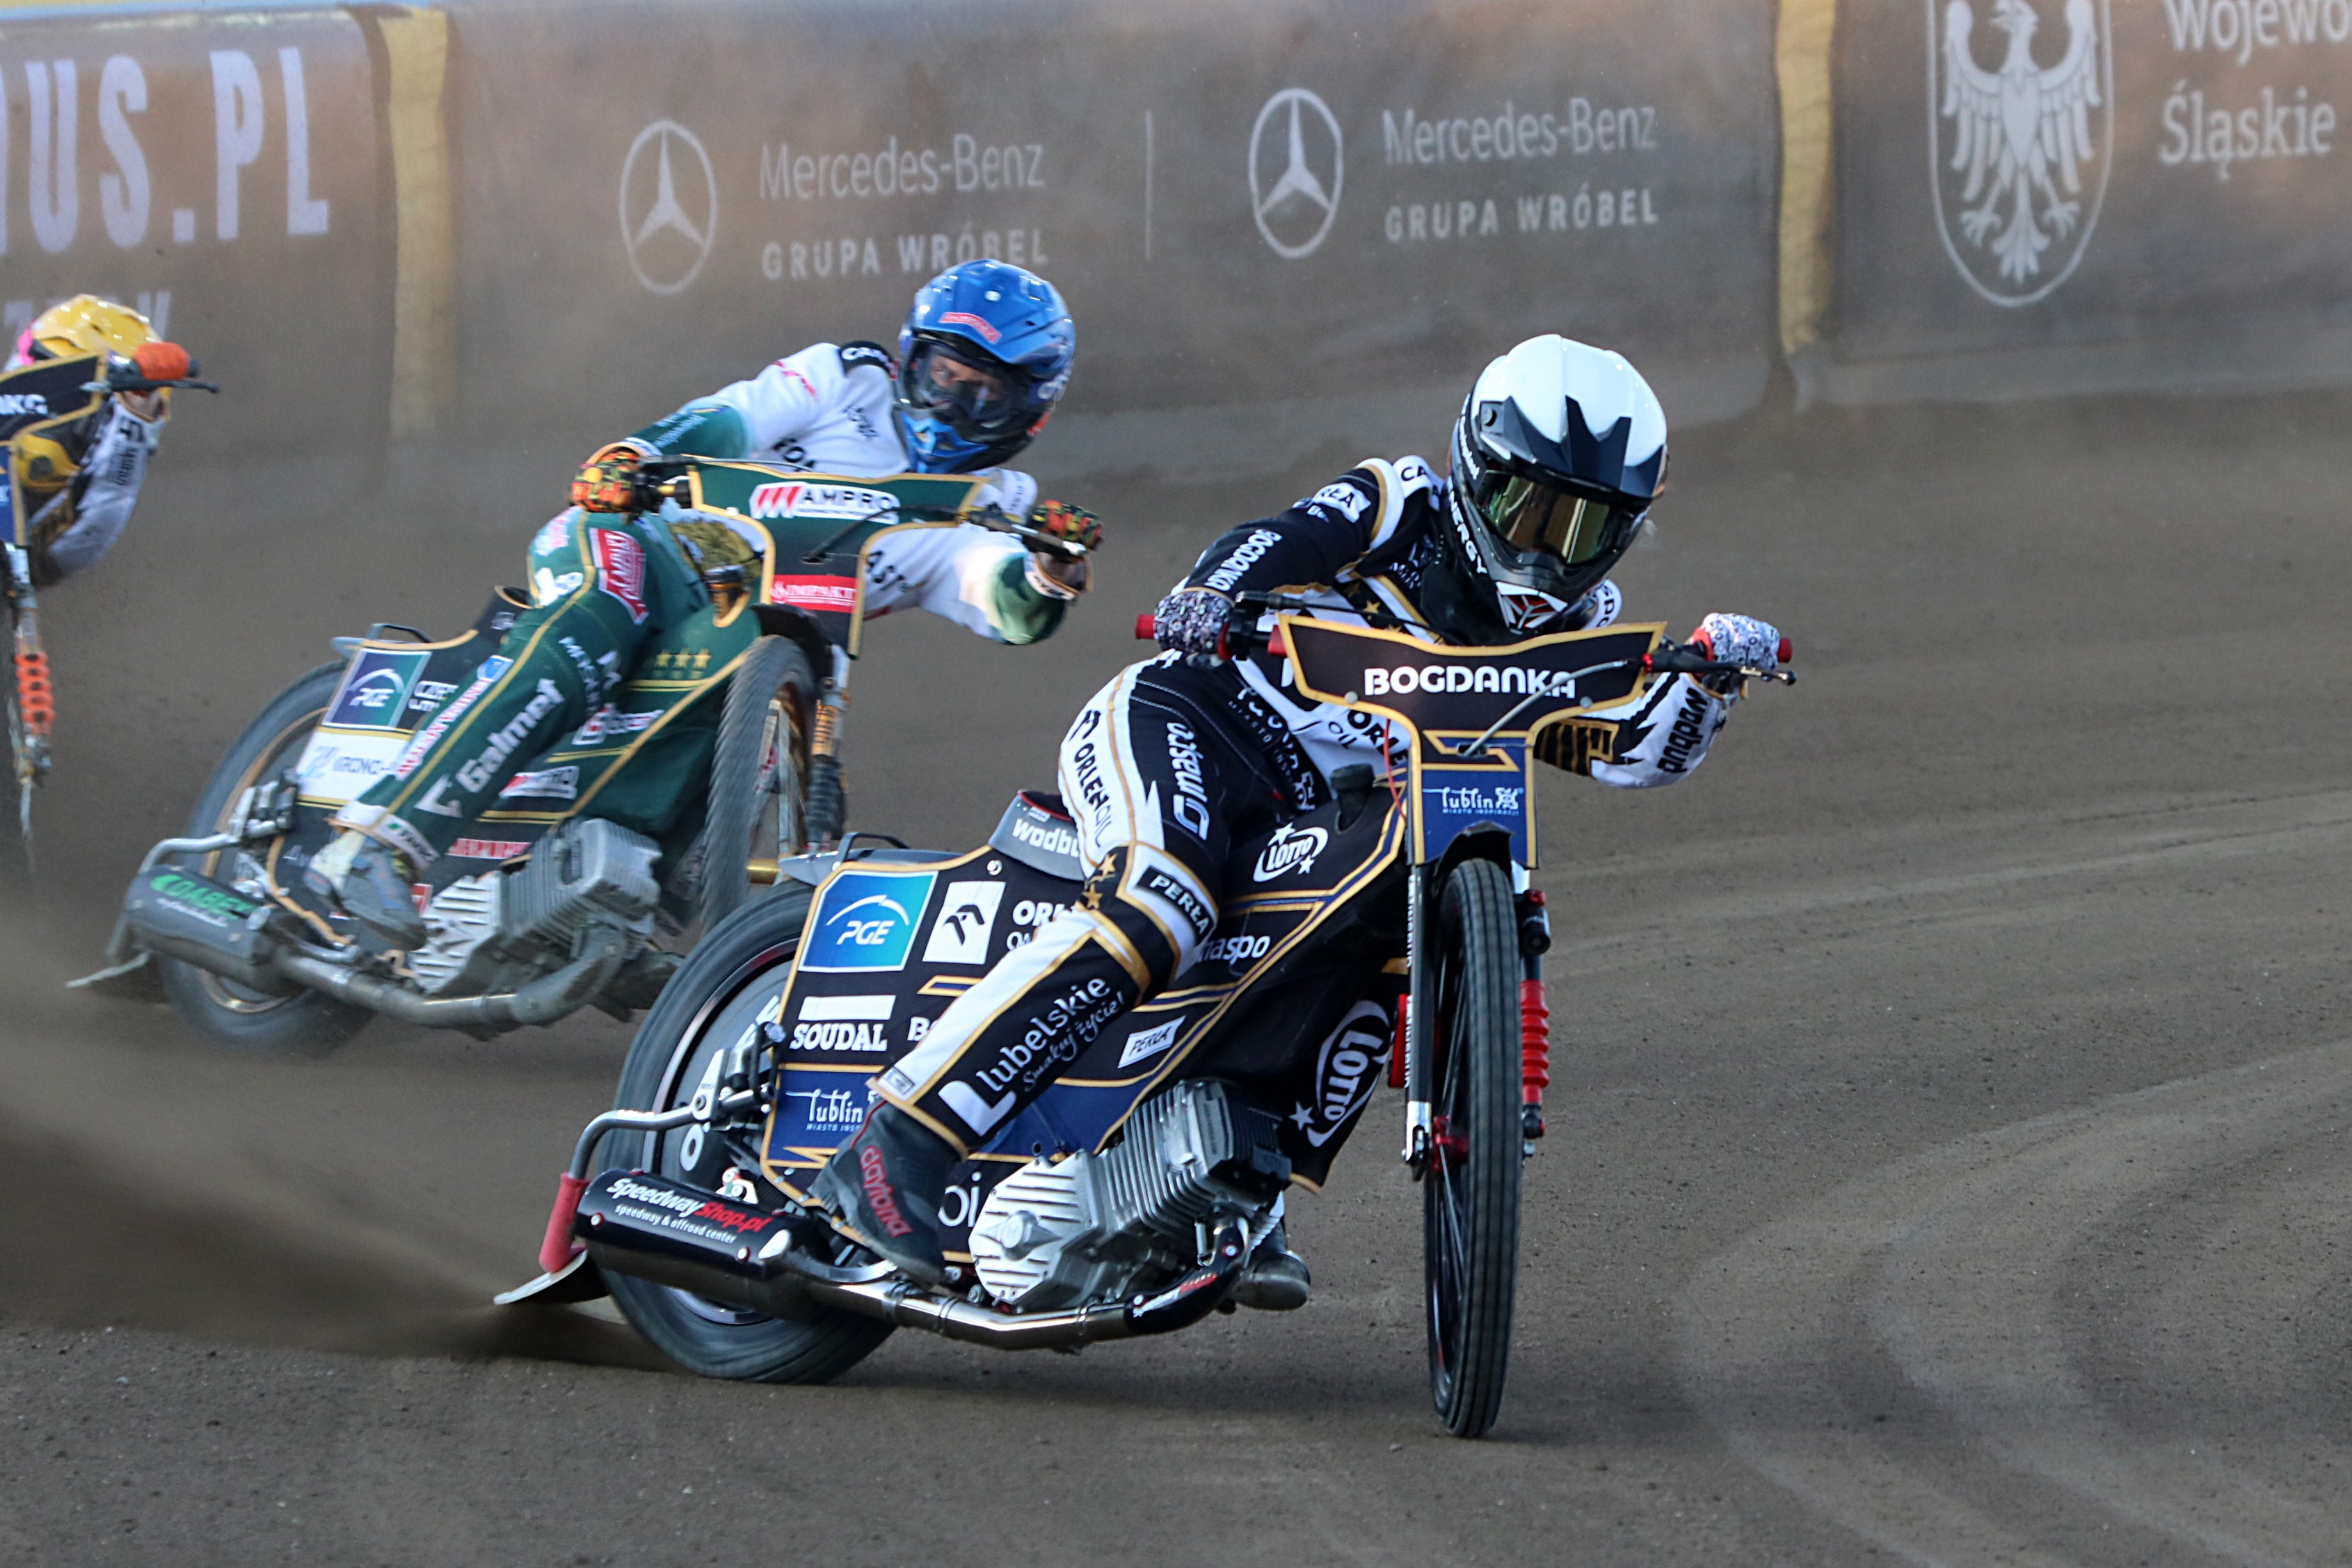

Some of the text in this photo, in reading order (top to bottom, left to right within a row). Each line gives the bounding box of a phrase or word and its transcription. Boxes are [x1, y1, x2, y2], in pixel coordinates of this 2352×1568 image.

[0, 46, 330, 255] US.PL
[1384, 97, 1658, 166] Mercedes-Benz
[2159, 79, 2337, 182] Śląskie
[759, 134, 1044, 201] Mercedes-Benz
[1385, 183, 1659, 242] GRUPA WRÓBEL
[761, 222, 1048, 280] GRUPA WRÓBEL
[1364, 666, 1576, 699] BOGDANKA
[1074, 742, 1110, 812] ORLEN
[1265, 836, 1314, 871] LOTTO
[836, 920, 895, 945] PGE
[1149, 874, 1210, 936] PERŁA
[790, 1023, 888, 1052] SOUDAL
[1324, 1030, 1385, 1121] LOTTO
[806, 1123, 838, 1132] MIASTO
[615, 1203, 737, 1245] speedway & offroad center
